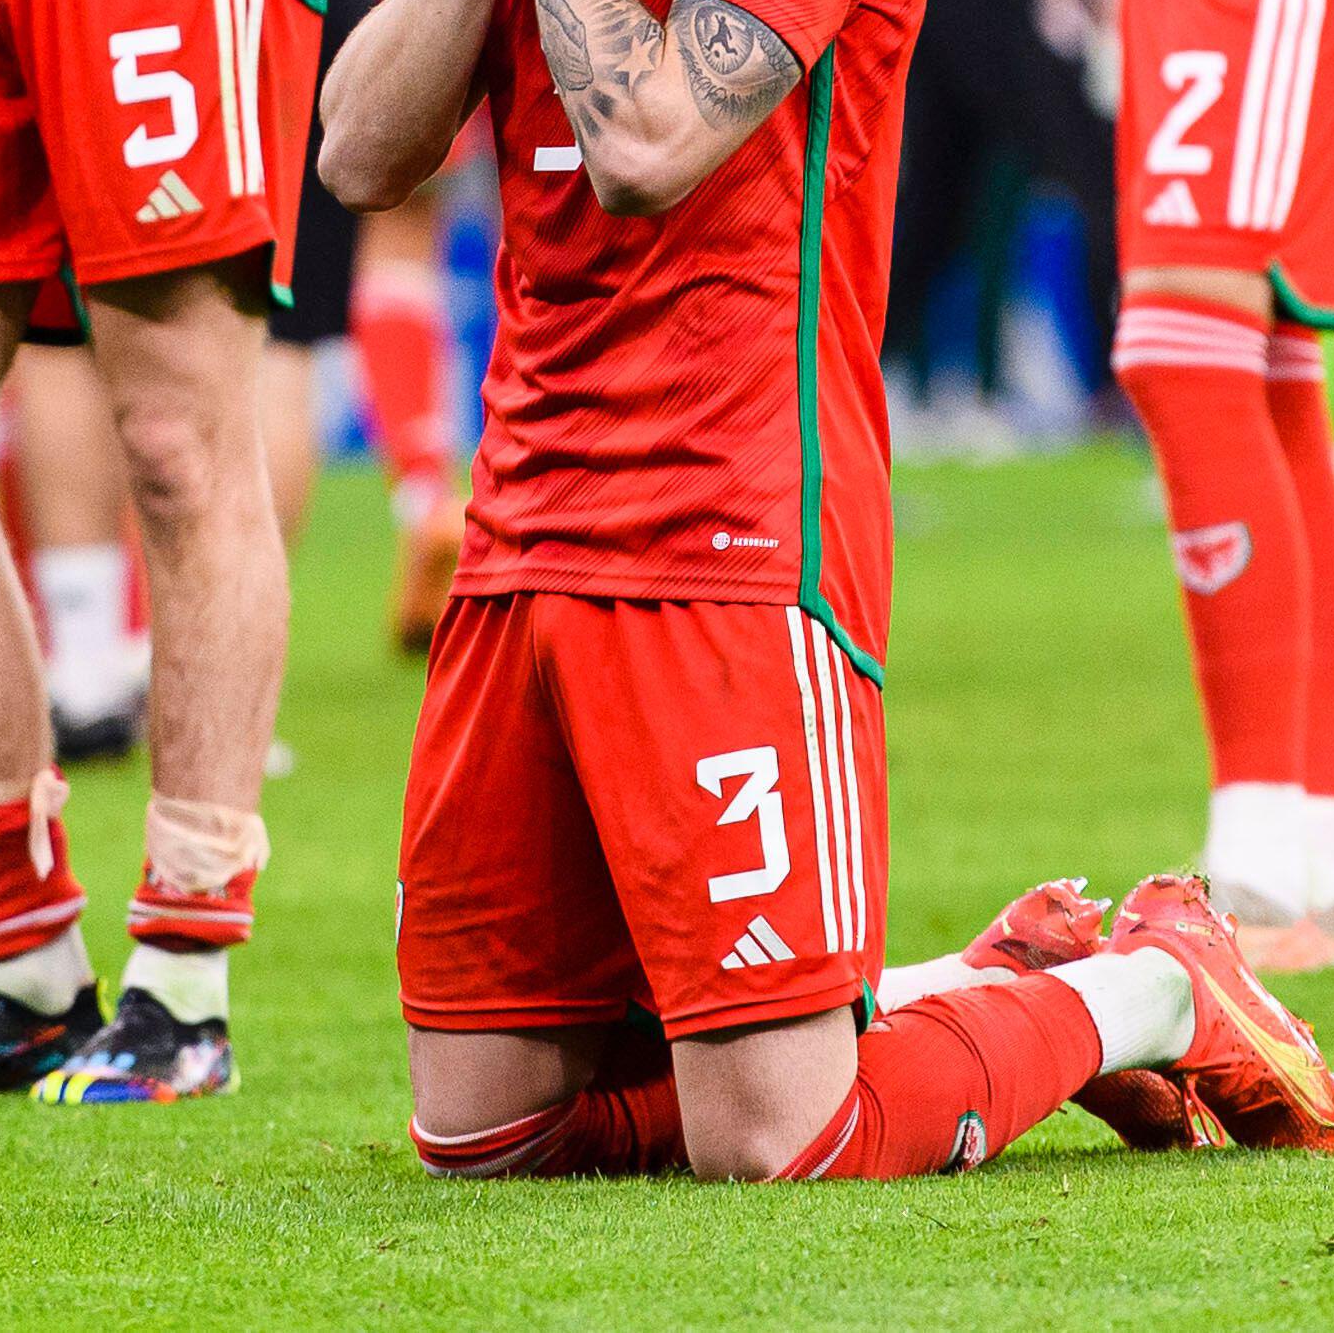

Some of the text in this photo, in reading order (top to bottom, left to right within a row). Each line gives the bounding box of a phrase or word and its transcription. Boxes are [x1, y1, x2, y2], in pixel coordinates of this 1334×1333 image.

[108, 24, 199, 168] 5
[1146, 50, 1228, 175] 2
[696, 745, 791, 904] 3
